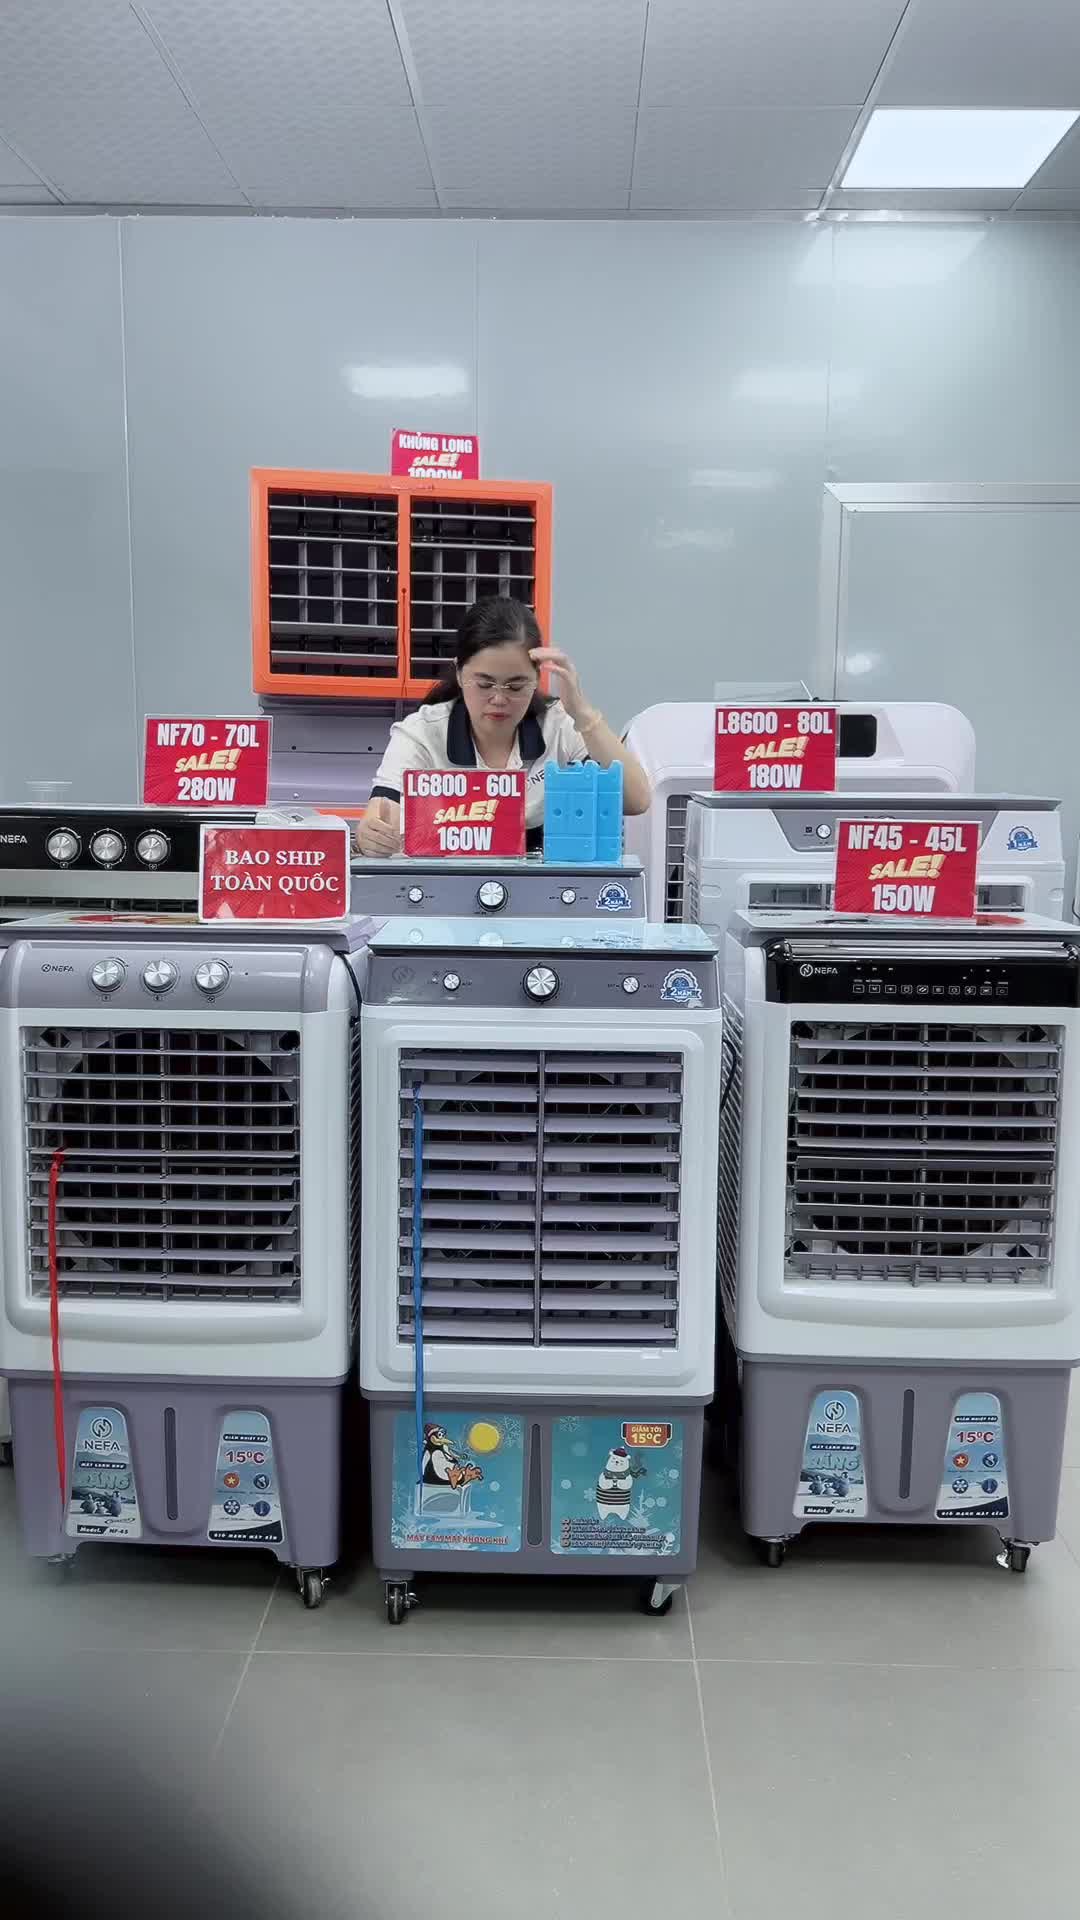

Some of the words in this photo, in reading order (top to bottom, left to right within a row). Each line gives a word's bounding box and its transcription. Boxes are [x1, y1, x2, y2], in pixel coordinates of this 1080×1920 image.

[399, 432, 439, 451] KHỦNG
[442, 438, 473, 453] LONG
[412, 453, 461, 468] SALE!
[718, 711, 778, 734] L8600
[797, 711, 833, 734] 80L
[157, 723, 205, 746] NF70
[225, 724, 260, 747] 70L
[174, 748, 242, 773] SALE!
[743, 736, 809, 761] SALE!
[177, 776, 236, 801] 280W
[407, 773, 467, 797] L6800
[486, 774, 521, 797] 60L
[747, 764, 803, 789] 180W
[433, 799, 499, 825] SALE!
[0, 834, 28, 844] NEFA
[437, 826, 493, 851] 160W
[848, 825, 903, 850] NF45
[924, 826, 967, 852] 45L
[225, 850, 270, 865] BAO
[276, 850, 326, 866] SHIP
[868, 854, 946, 880] SALE!
[211, 871, 272, 891] TOÀN
[278, 872, 339, 895] QUỐC
[872, 884, 936, 912] 150W
[814, 967, 838, 975] NEFA
[816, 1423, 851, 1433] NEFA
[84, 1440, 121, 1451] NEFA
